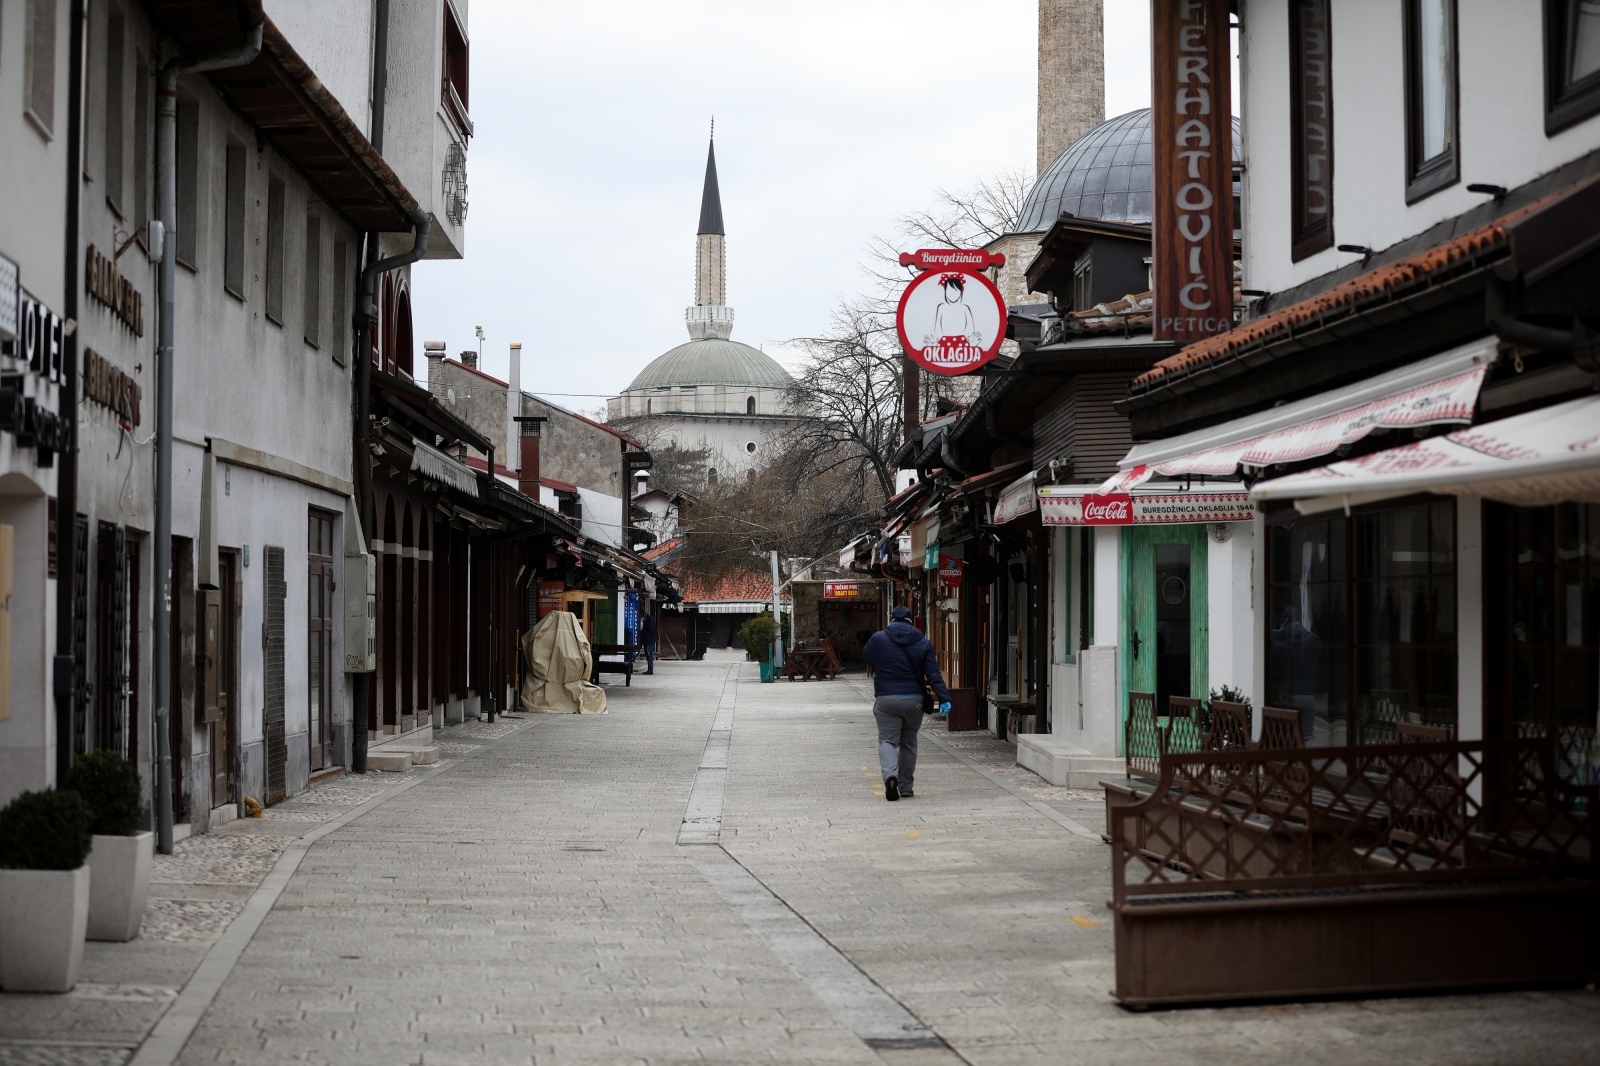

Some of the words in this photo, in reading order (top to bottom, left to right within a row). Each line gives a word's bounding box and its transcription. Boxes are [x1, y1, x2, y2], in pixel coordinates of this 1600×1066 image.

[921, 251, 983, 266] Buregdžinica
[1161, 317, 1230, 333] PETICA
[923, 346, 981, 362] OKLAGIJA
[1084, 500, 1128, 520] Coca-Cola
[1142, 505, 1197, 514] BUREGDŽINICA
[1198, 505, 1235, 513] OKLAGIJA
